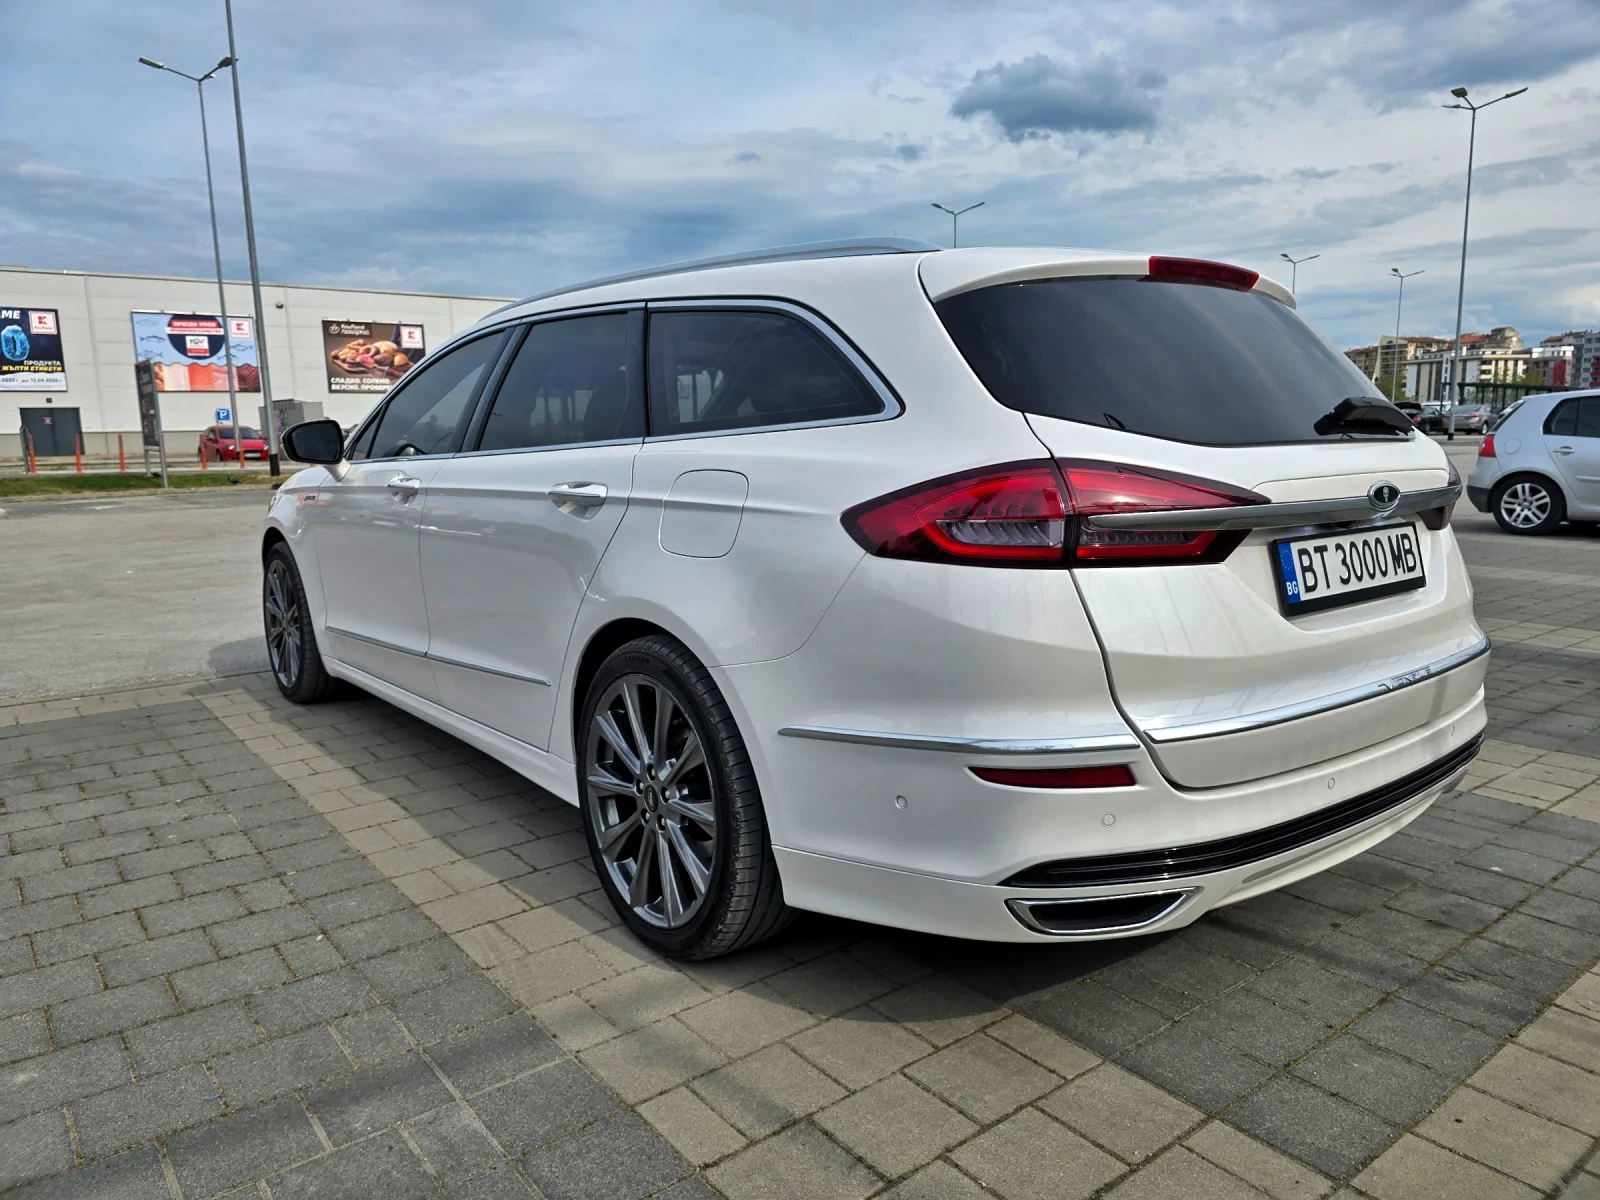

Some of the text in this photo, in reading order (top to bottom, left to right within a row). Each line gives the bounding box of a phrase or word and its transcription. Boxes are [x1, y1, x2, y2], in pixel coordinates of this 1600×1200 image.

[220, 410, 228, 419] P
[1297, 533, 1417, 593] BT 3000 MB
[1286, 581, 1299, 596] BG
